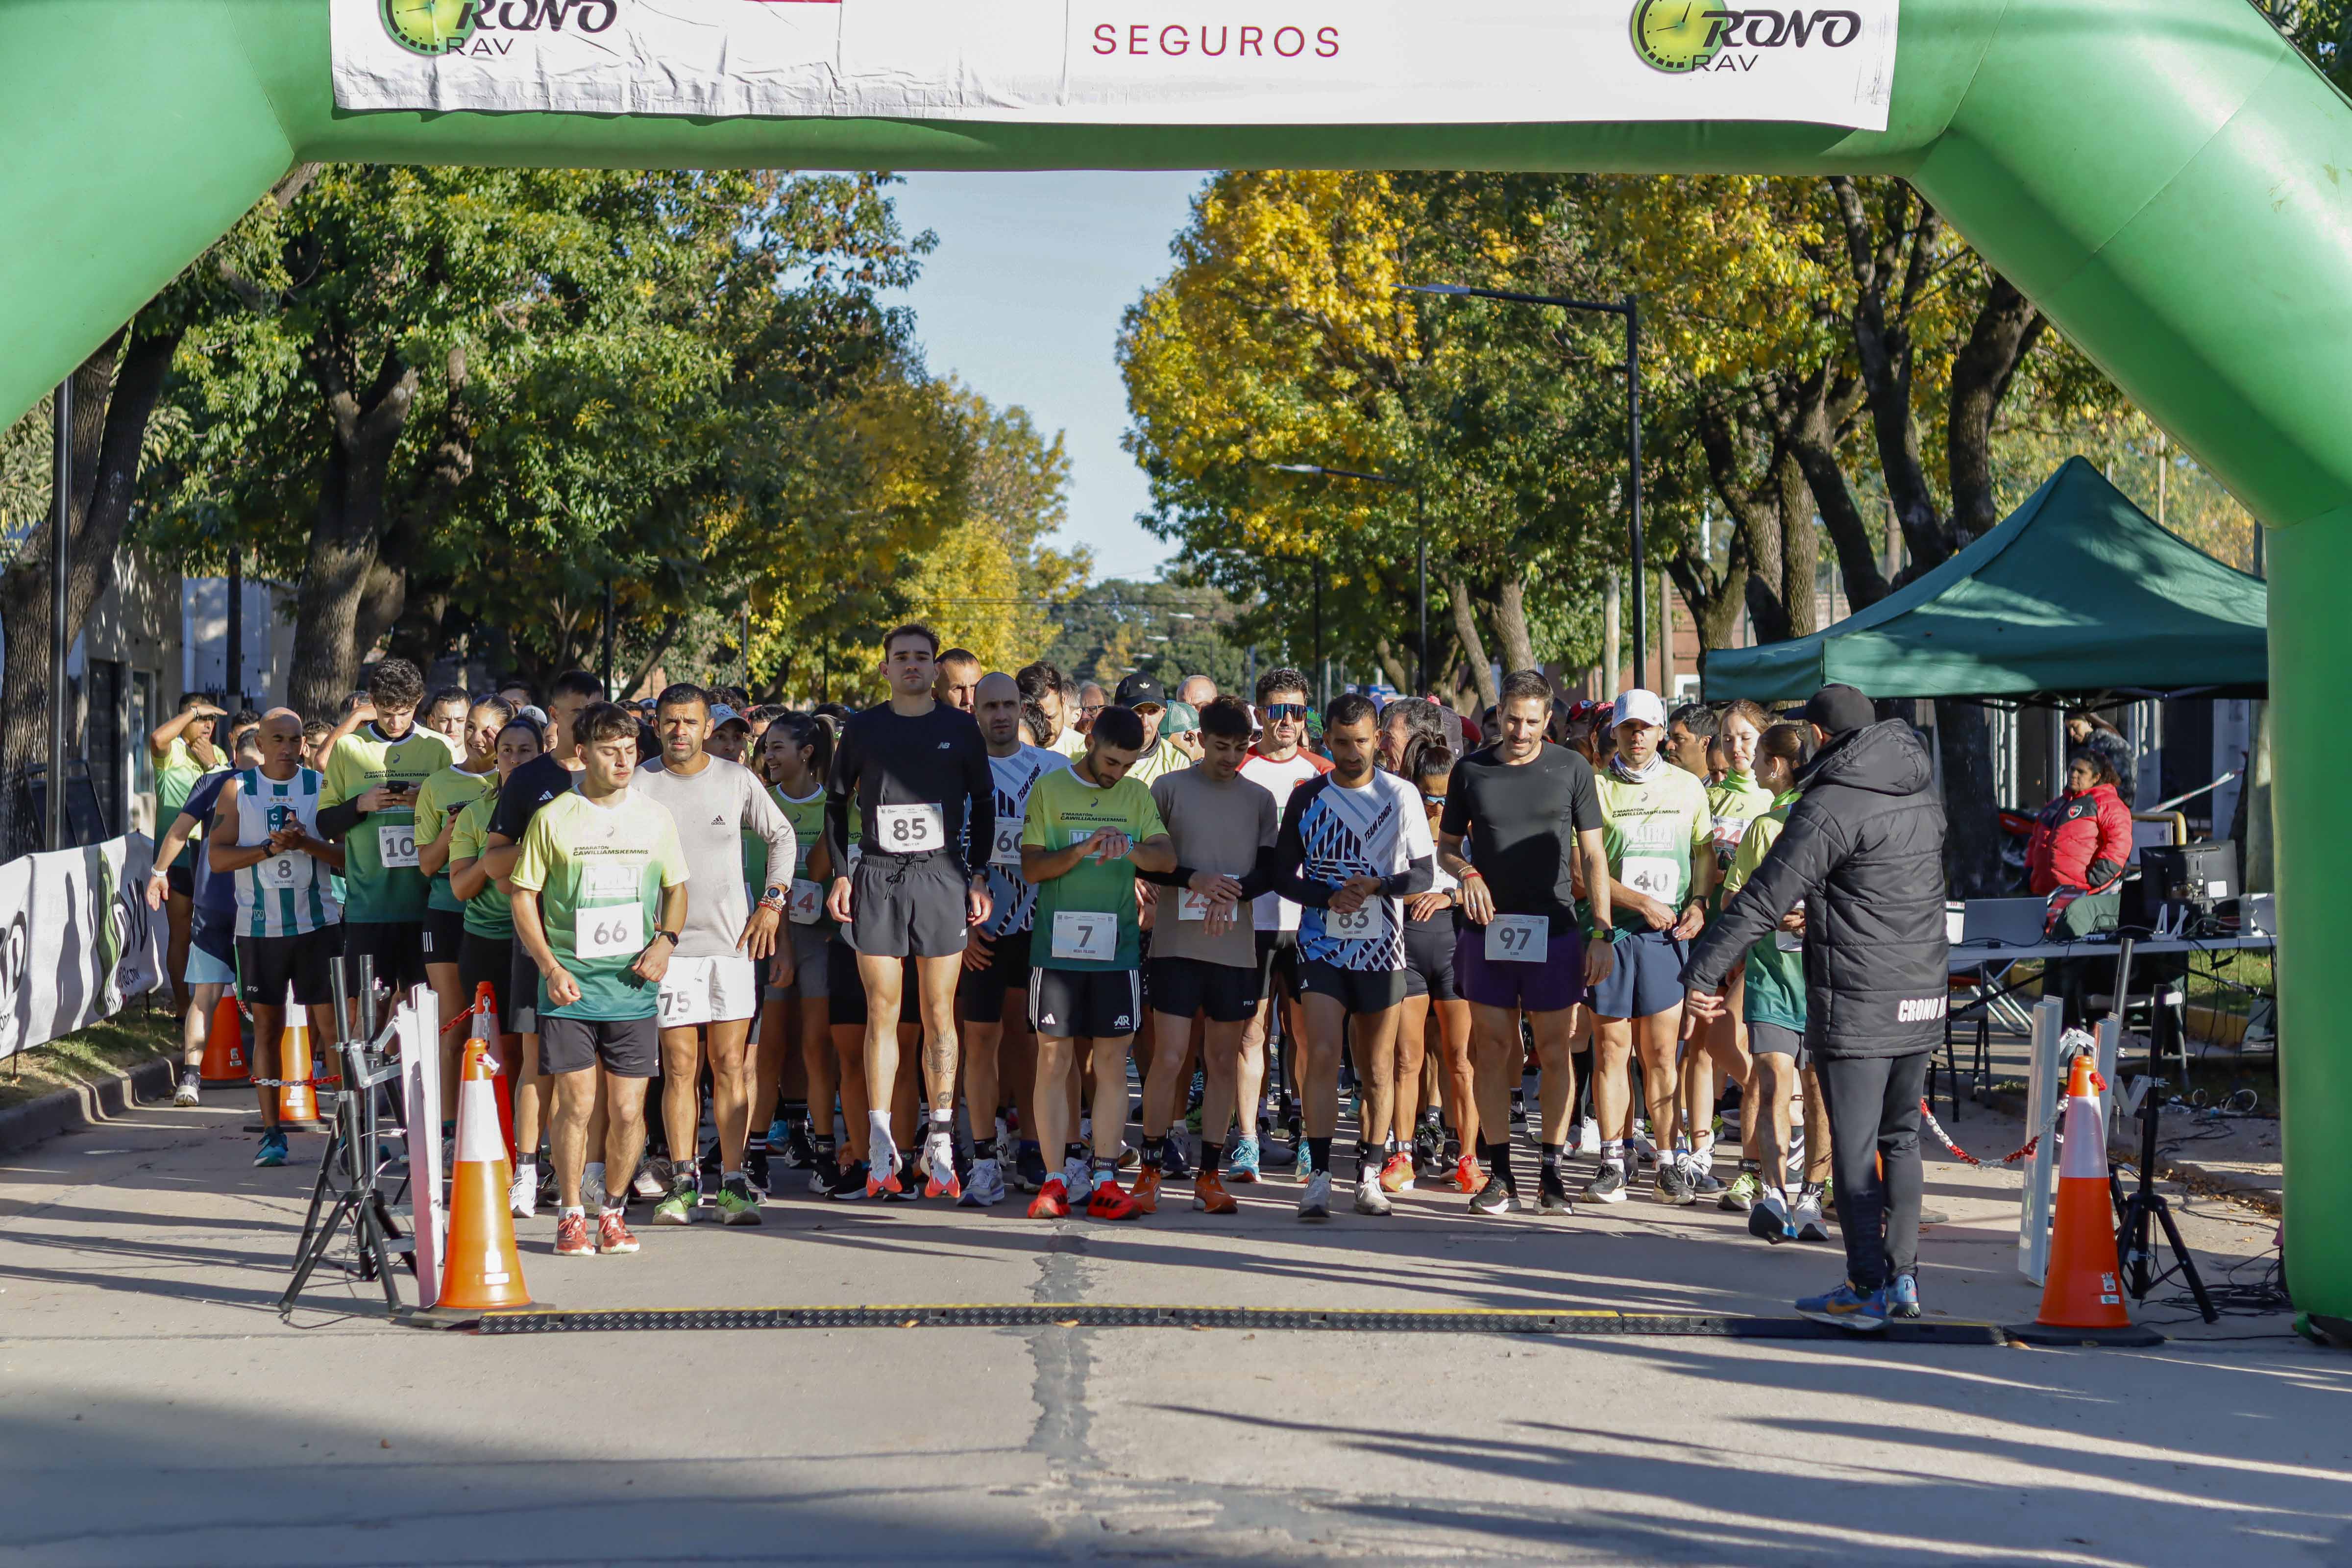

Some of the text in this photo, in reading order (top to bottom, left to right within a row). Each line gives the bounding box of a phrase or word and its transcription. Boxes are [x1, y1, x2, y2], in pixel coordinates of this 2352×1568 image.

[446, 37, 514, 55] RAV
[1093, 24, 1339, 57] SEGUROS
[1691, 54, 1759, 72] RAV
[1017, 763, 1041, 802] TEAM CONDE
[893, 818, 927, 841] 85
[1365, 801, 1392, 843] TEAM CONDE
[386, 837, 416, 857] 10
[278, 859, 292, 878] 8
[1634, 870, 1668, 892] 40
[1339, 907, 1369, 929] 83
[594, 920, 627, 945] 66
[1078, 925, 1093, 947] 7
[1499, 928, 1532, 950] 97
[660, 991, 691, 1016] 75
[1898, 998, 1939, 1022] CRONO
